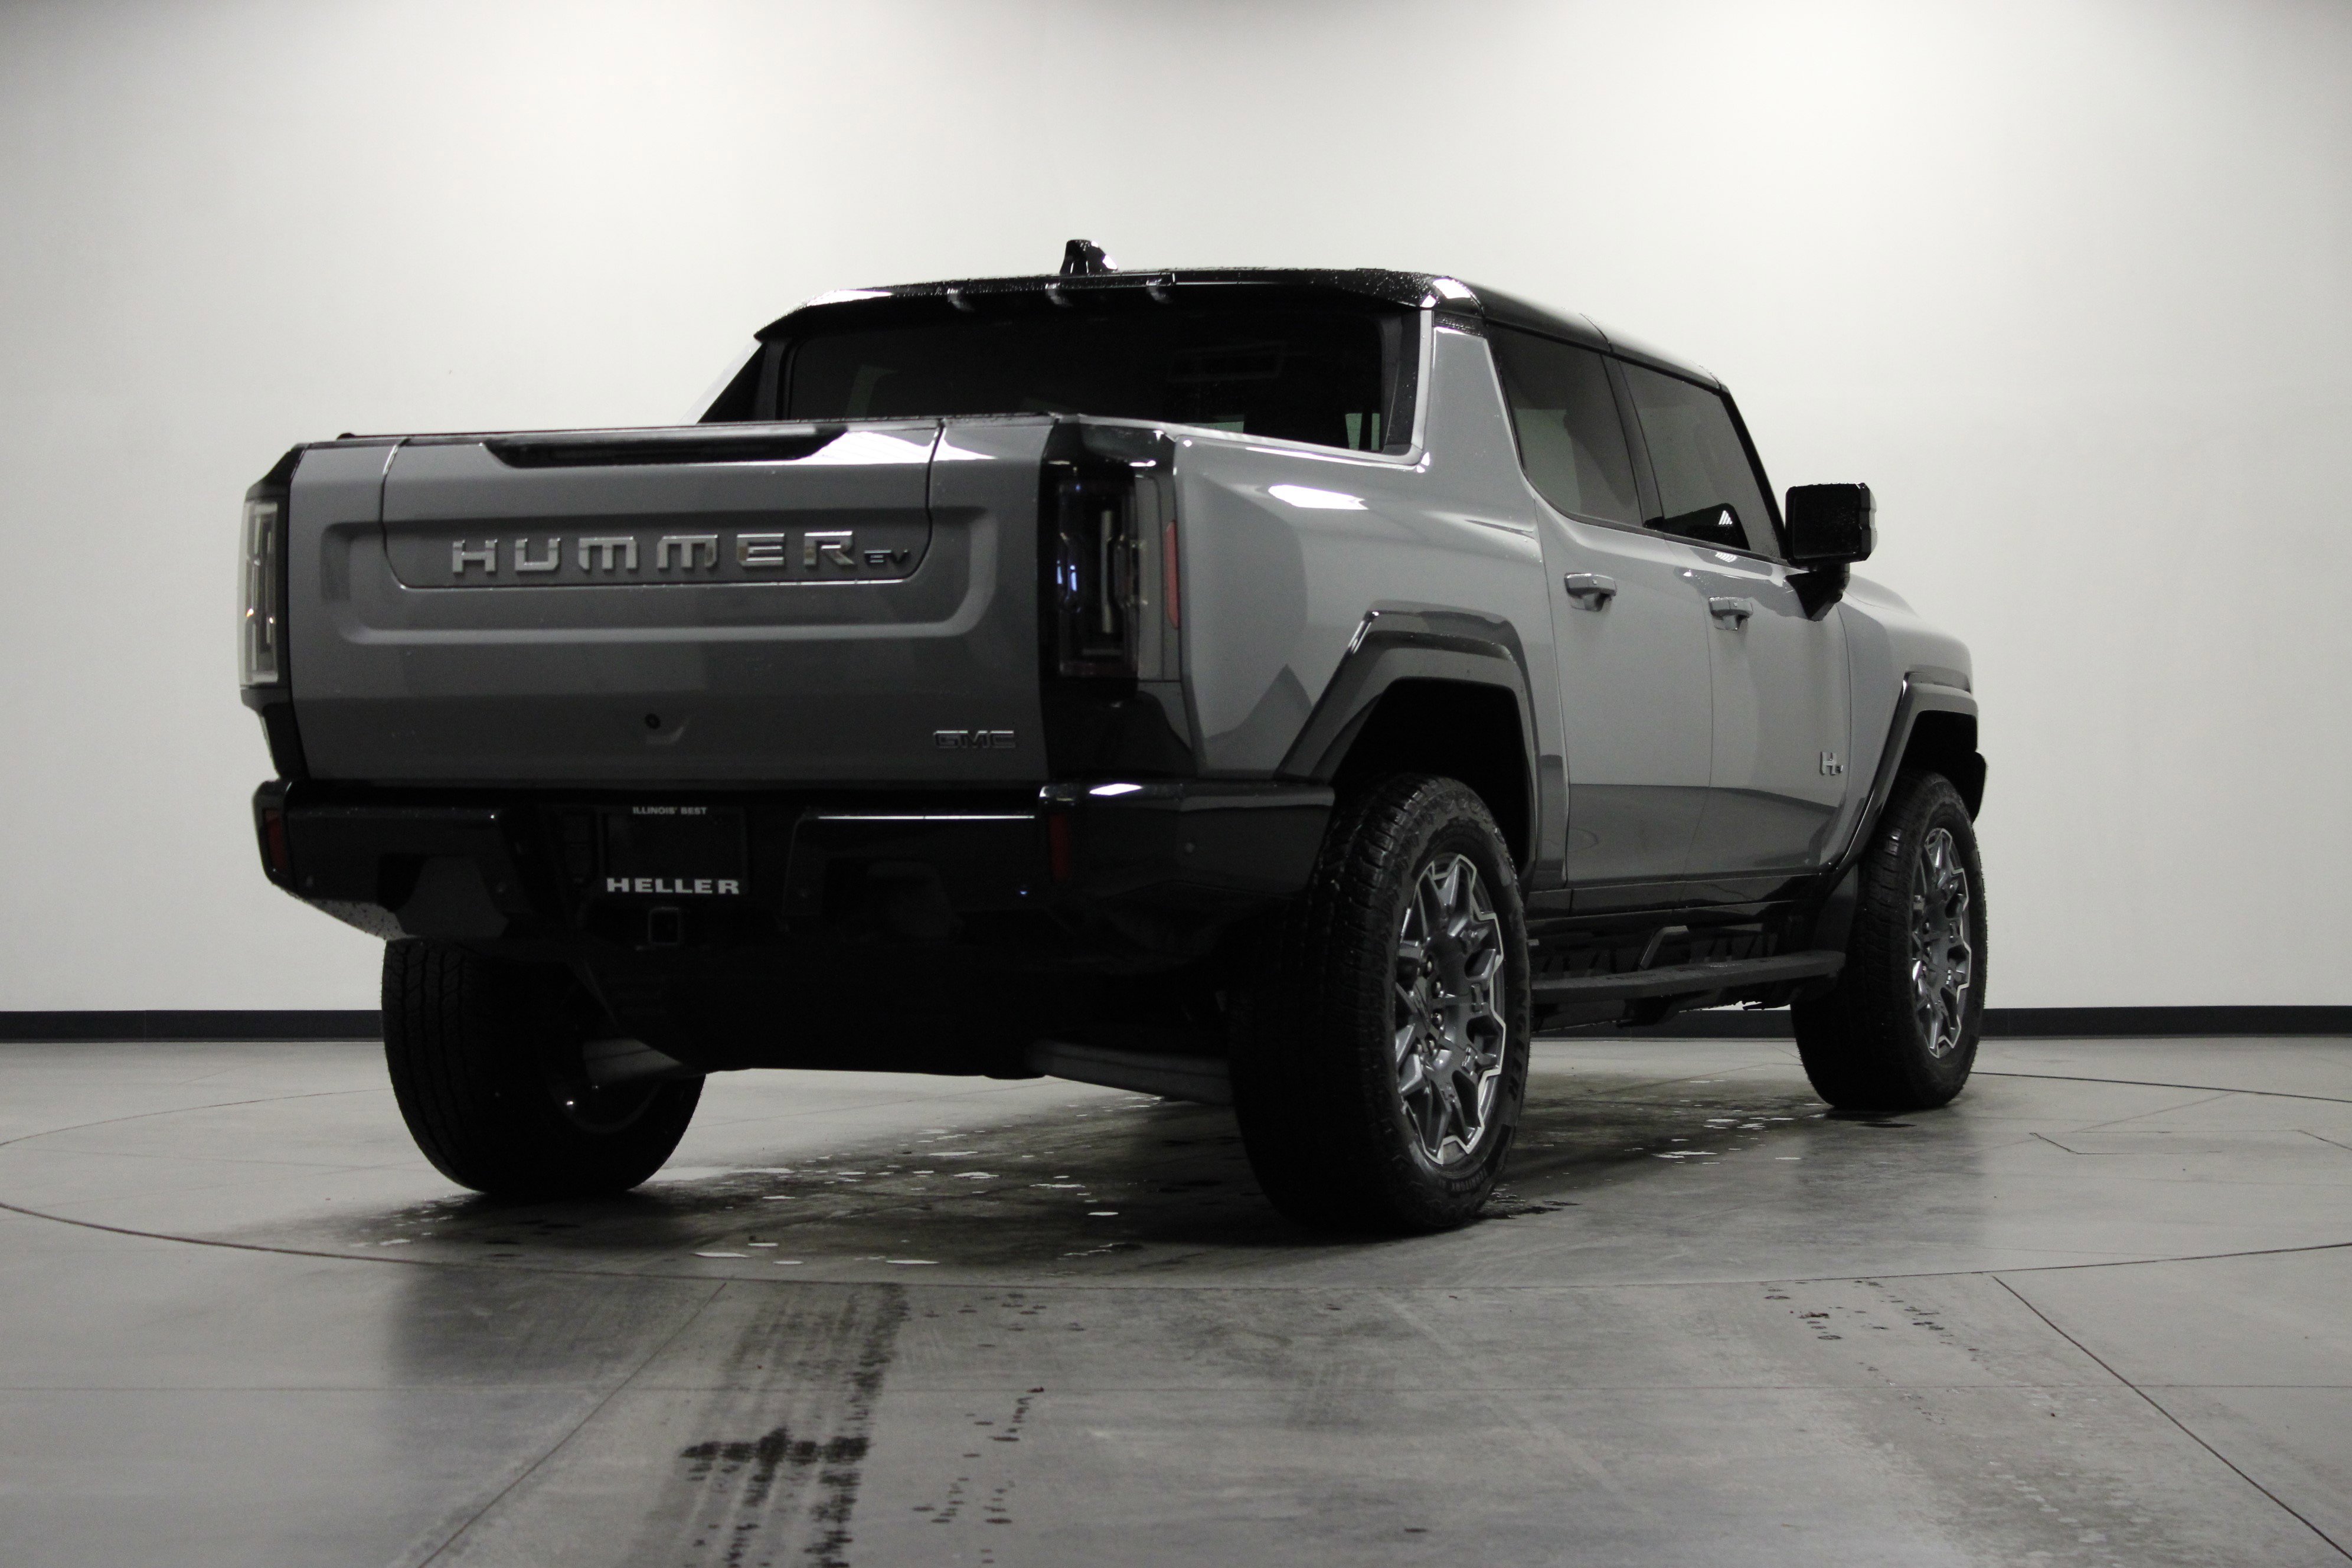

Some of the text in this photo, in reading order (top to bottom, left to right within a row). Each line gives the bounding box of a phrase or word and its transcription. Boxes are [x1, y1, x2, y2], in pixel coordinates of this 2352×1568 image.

[453, 531, 911, 573] HUMMER EV
[933, 730, 1016, 749] GMC
[680, 806, 708, 815] BEST
[606, 877, 739, 895] HELLER
